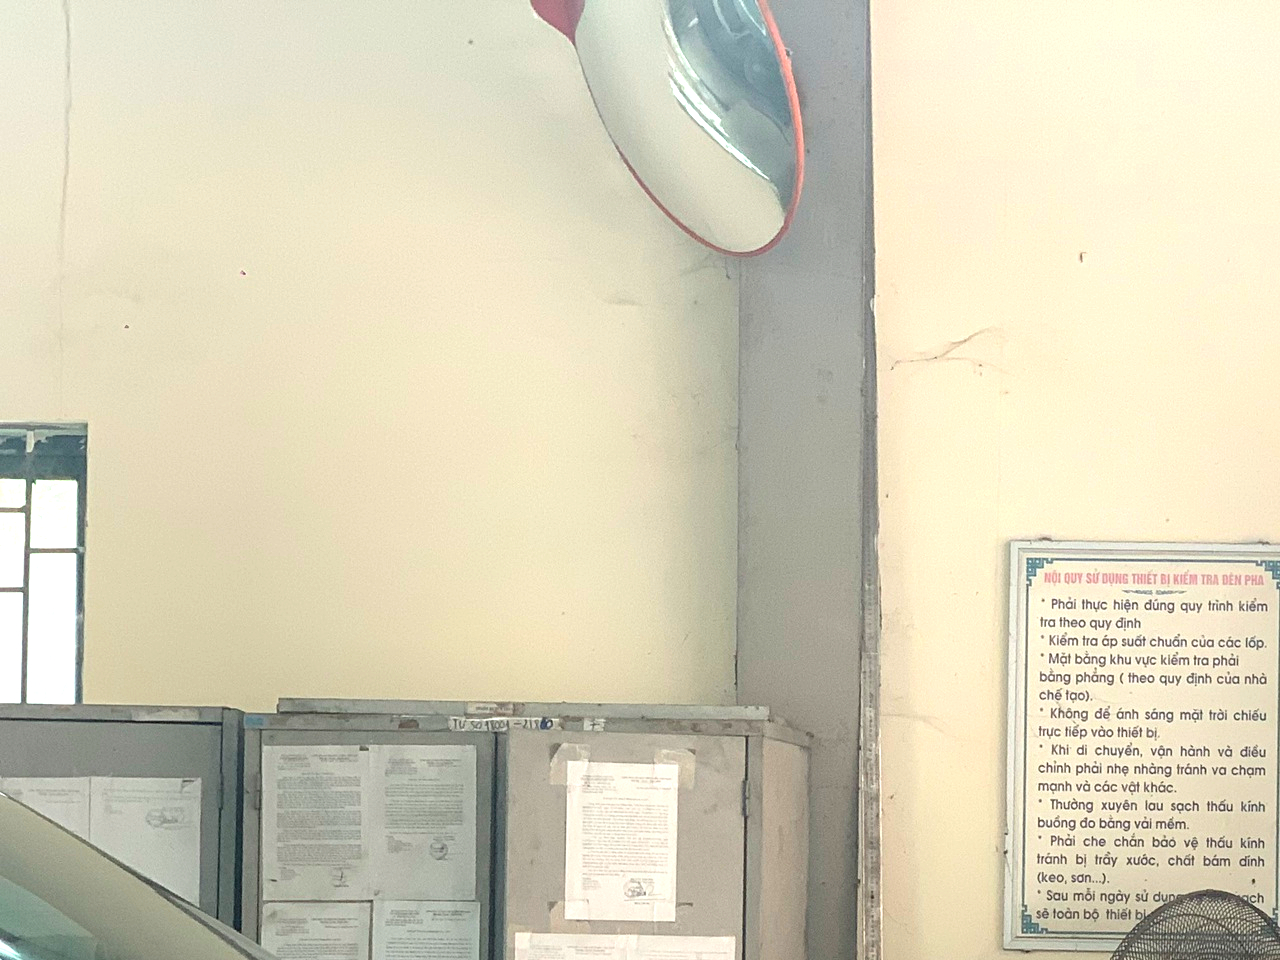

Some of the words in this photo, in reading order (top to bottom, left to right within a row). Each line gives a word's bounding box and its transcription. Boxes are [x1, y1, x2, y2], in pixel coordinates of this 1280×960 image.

[1044, 570, 1060, 585] NỘI
[1064, 572, 1083, 585] QUY
[1086, 569, 1100, 584] SỬ
[1102, 573, 1128, 586] DỤNG
[1161, 573, 1170, 587] BỊ
[1201, 574, 1219, 585] TRA
[1245, 575, 1264, 586] PHA
[1051, 596, 1077, 610] Phải
[1081, 599, 1108, 613] thực
[1113, 599, 1139, 613] hiện
[1144, 598, 1175, 614] đúng
[1180, 602, 1203, 614] quy
[1208, 599, 1233, 612] trình
[1238, 597, 1268, 612] kiểm
[1040, 616, 1056, 628] tra
[1059, 617, 1086, 628] theo
[1089, 619, 1112, 631] quy
[1115, 617, 1141, 632] định
[1049, 632, 1079, 646] Kiểm
[1082, 635, 1098, 647] tra
[1101, 634, 1118, 649] áp
[1121, 634, 1146, 647] suất
[1149, 633, 1188, 648] chuẩn
[1191, 634, 1215, 648] của
[1217, 636, 1241, 648] các
[1245, 635, 1267, 651] lốp.
[1048, 652, 1071, 667] Mặt
[1074, 650, 1107, 668] bằng
[1110, 653, 1132, 665] khu
[1135, 656, 1157, 668] vực
[1160, 651, 1190, 666] kiểm
[1193, 654, 1209, 666] tra
[1212, 653, 1239, 669] phải
[1039, 667, 1071, 686] bằng
[1075, 667, 1115, 686] phẳng
[1127, 672, 1155, 684] theo
[1159, 674, 1182, 686] quy
[1186, 672, 1212, 687] định
[1216, 671, 1240, 685] của
[1244, 672, 1267, 685] nhà
[1039, 688, 1062, 701] chế
[1066, 689, 1093, 703] tạo).
[1050, 706, 1088, 722] Không
[1094, 705, 1111, 722] để
[1116, 707, 1139, 720] ánh
[1144, 708, 1174, 723] sáng
[1180, 709, 1203, 723] mặt
[1209, 708, 1227, 721] trời
[1233, 708, 1267, 721] chiếu
[1038, 726, 1061, 739] trực
[1065, 724, 1088, 740] tiếp
[1090, 725, 1114, 738] vào
[1117, 725, 1143, 738] thiết
[1146, 727, 1160, 741] bị.
[1052, 744, 1070, 755] Khi
[1076, 744, 1088, 756] di
[1094, 742, 1143, 759] chuyển,
[1150, 745, 1173, 760] vận
[1180, 744, 1210, 757] hành
[1217, 745, 1233, 758] và
[1240, 744, 1266, 758] điều
[1038, 760, 1071, 774] chỉnh
[1075, 760, 1102, 776] phải
[1106, 763, 1129, 777] nhẹ
[1134, 762, 1172, 778] nhàng
[1176, 763, 1207, 775] tránh
[1211, 766, 1227, 776] va
[1231, 764, 1266, 779] chạm
[1038, 780, 1072, 795] mạnh
[1075, 779, 1091, 792] và
[1094, 780, 1118, 793] các
[1121, 781, 1140, 796] vật
[1144, 781, 1176, 794] khác.
[1050, 797, 1094, 814] Thường
[1101, 799, 1138, 813] xuyên
[1145, 799, 1164, 811] lau
[1170, 800, 1199, 814] sạch
[1206, 799, 1233, 812] thấu
[1241, 800, 1266, 812] kính
[1080, 815, 1096, 828] đo
[1099, 814, 1131, 832] bằng
[1134, 816, 1152, 829] vải
[1050, 833, 1076, 847] Phải
[1082, 835, 1106, 847] che
[1114, 832, 1145, 848] chắn
[1183, 836, 1199, 851] vệ
[1206, 835, 1233, 849] thấu
[1240, 837, 1265, 849] kính
[1037, 852, 1067, 865] tránh
[1075, 853, 1087, 868] bị
[1126, 853, 1159, 867] xước,
[1167, 853, 1195, 866] chất
[1203, 854, 1231, 867] bám
[1239, 855, 1265, 867] dính
[1037, 871, 1068, 885] (keo,
[1071, 873, 1110, 885] sơn...).
[1046, 889, 1068, 901] Sau
[1073, 887, 1095, 902] mỗi
[1100, 889, 1131, 905] ngày
[1135, 889, 1149, 902] sử
[1053, 907, 1080, 920] toàn
[1084, 908, 1099, 922] bộ
[1106, 908, 1131, 920] thiết
